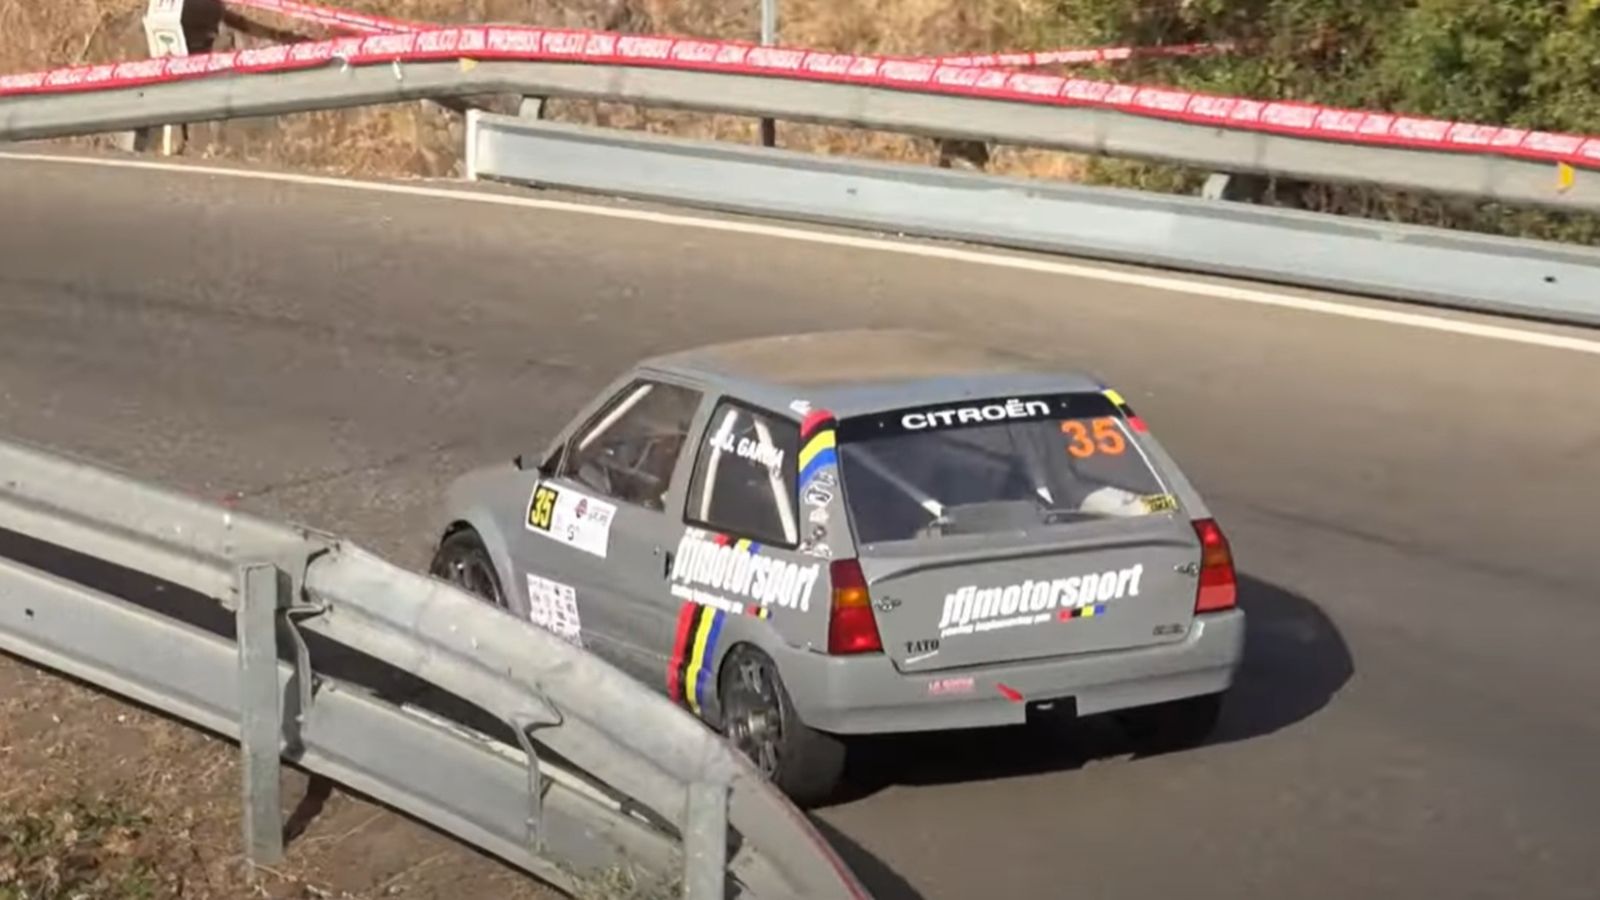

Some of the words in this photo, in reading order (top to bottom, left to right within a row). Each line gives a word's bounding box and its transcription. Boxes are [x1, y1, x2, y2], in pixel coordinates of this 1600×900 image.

[737, 437, 784, 468] GARA
[1061, 415, 1127, 459] 35
[531, 488, 556, 529] 35
[904, 639, 940, 654] TATO
